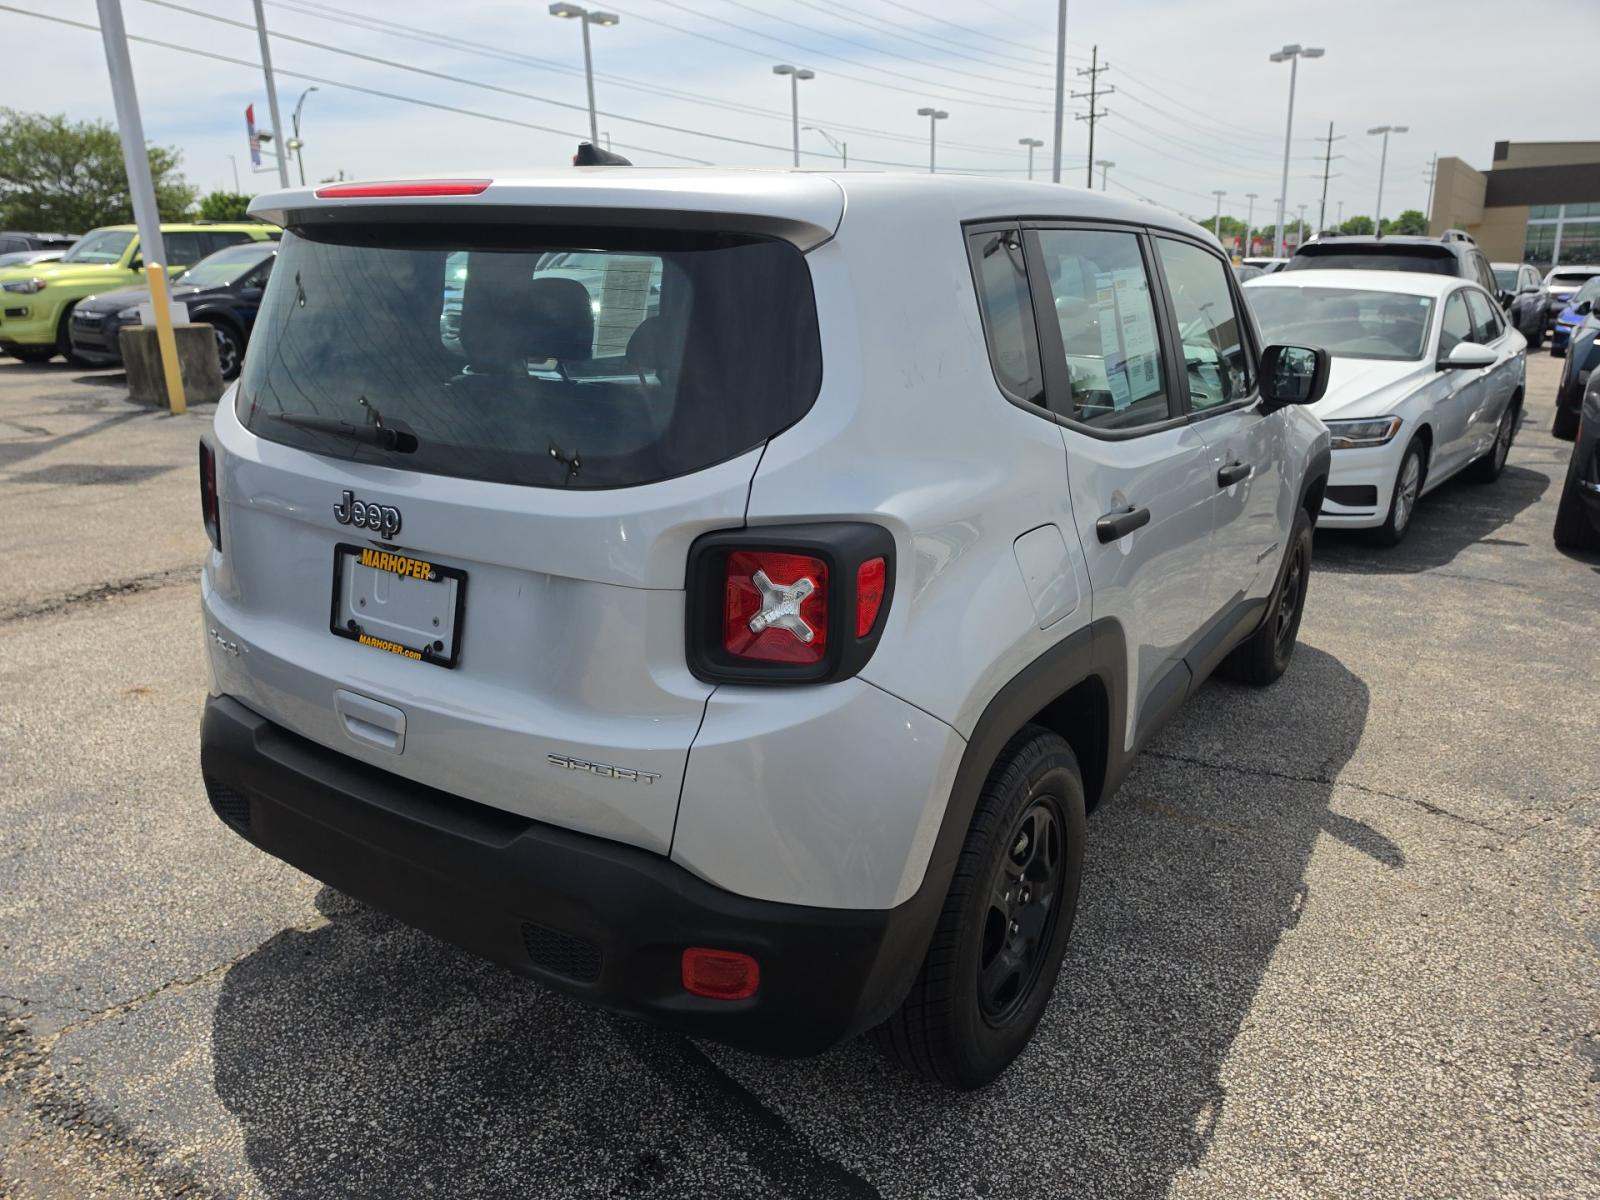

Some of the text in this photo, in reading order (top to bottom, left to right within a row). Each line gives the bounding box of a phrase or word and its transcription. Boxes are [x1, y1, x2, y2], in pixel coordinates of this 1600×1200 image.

[333, 490, 402, 539] Jeep
[361, 548, 430, 579] MARHOFER
[358, 634, 421, 660] MARHOFER.com
[546, 753, 661, 784] SPORT
